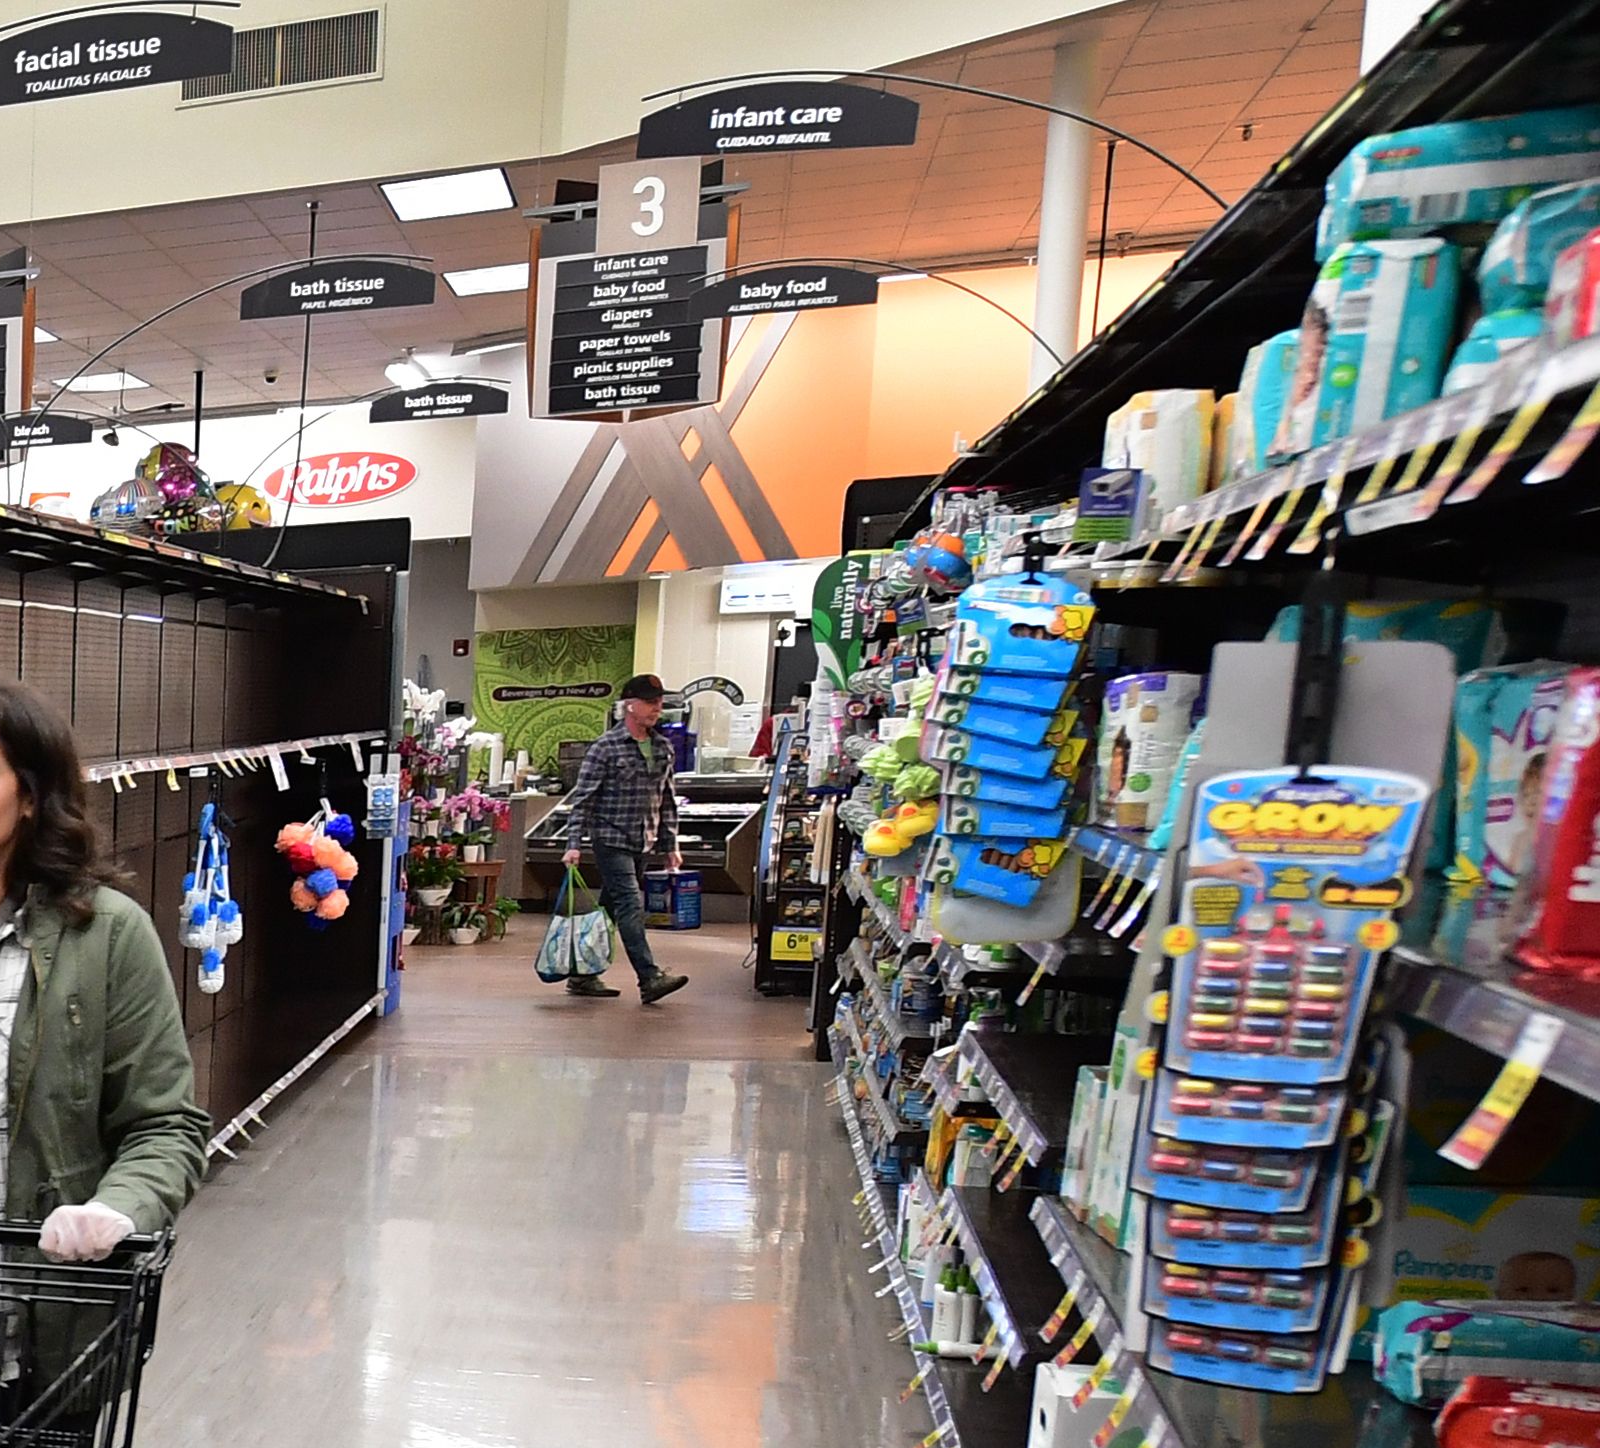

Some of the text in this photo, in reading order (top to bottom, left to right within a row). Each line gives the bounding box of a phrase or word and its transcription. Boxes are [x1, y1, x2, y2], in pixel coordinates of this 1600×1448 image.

[14, 37, 161, 74] facial tissue
[25, 65, 152, 94] TOALLITAS FACIALES
[709, 106, 843, 129] infant care
[716, 131, 831, 148] CUIDADO INFANTIL
[631, 176, 666, 237] 3
[593, 253, 669, 273] infant care
[290, 276, 385, 297] bath tissue
[593, 278, 666, 298] baby food
[740, 277, 827, 299] baby food
[301, 300, 327, 310] PAPEL
[601, 308, 653, 323] diapers
[579, 330, 671, 352] paper towels
[573, 356, 674, 378] picnic supplies
[404, 393, 473, 408] bath tissue
[584, 384, 661, 400] bath tissue
[14, 424, 50, 437] bleach
[276, 455, 400, 504] Ralphs
[829, 586, 843, 608] live
[840, 561, 863, 640] naturally
[501, 689, 542, 698] Beverages
[544, 688, 556, 696] for
[566, 687, 586, 695] New
[588, 686, 605, 696] Age
[1208, 801, 1403, 835] GROW
[1394, 1249, 1496, 1280] Pampers
